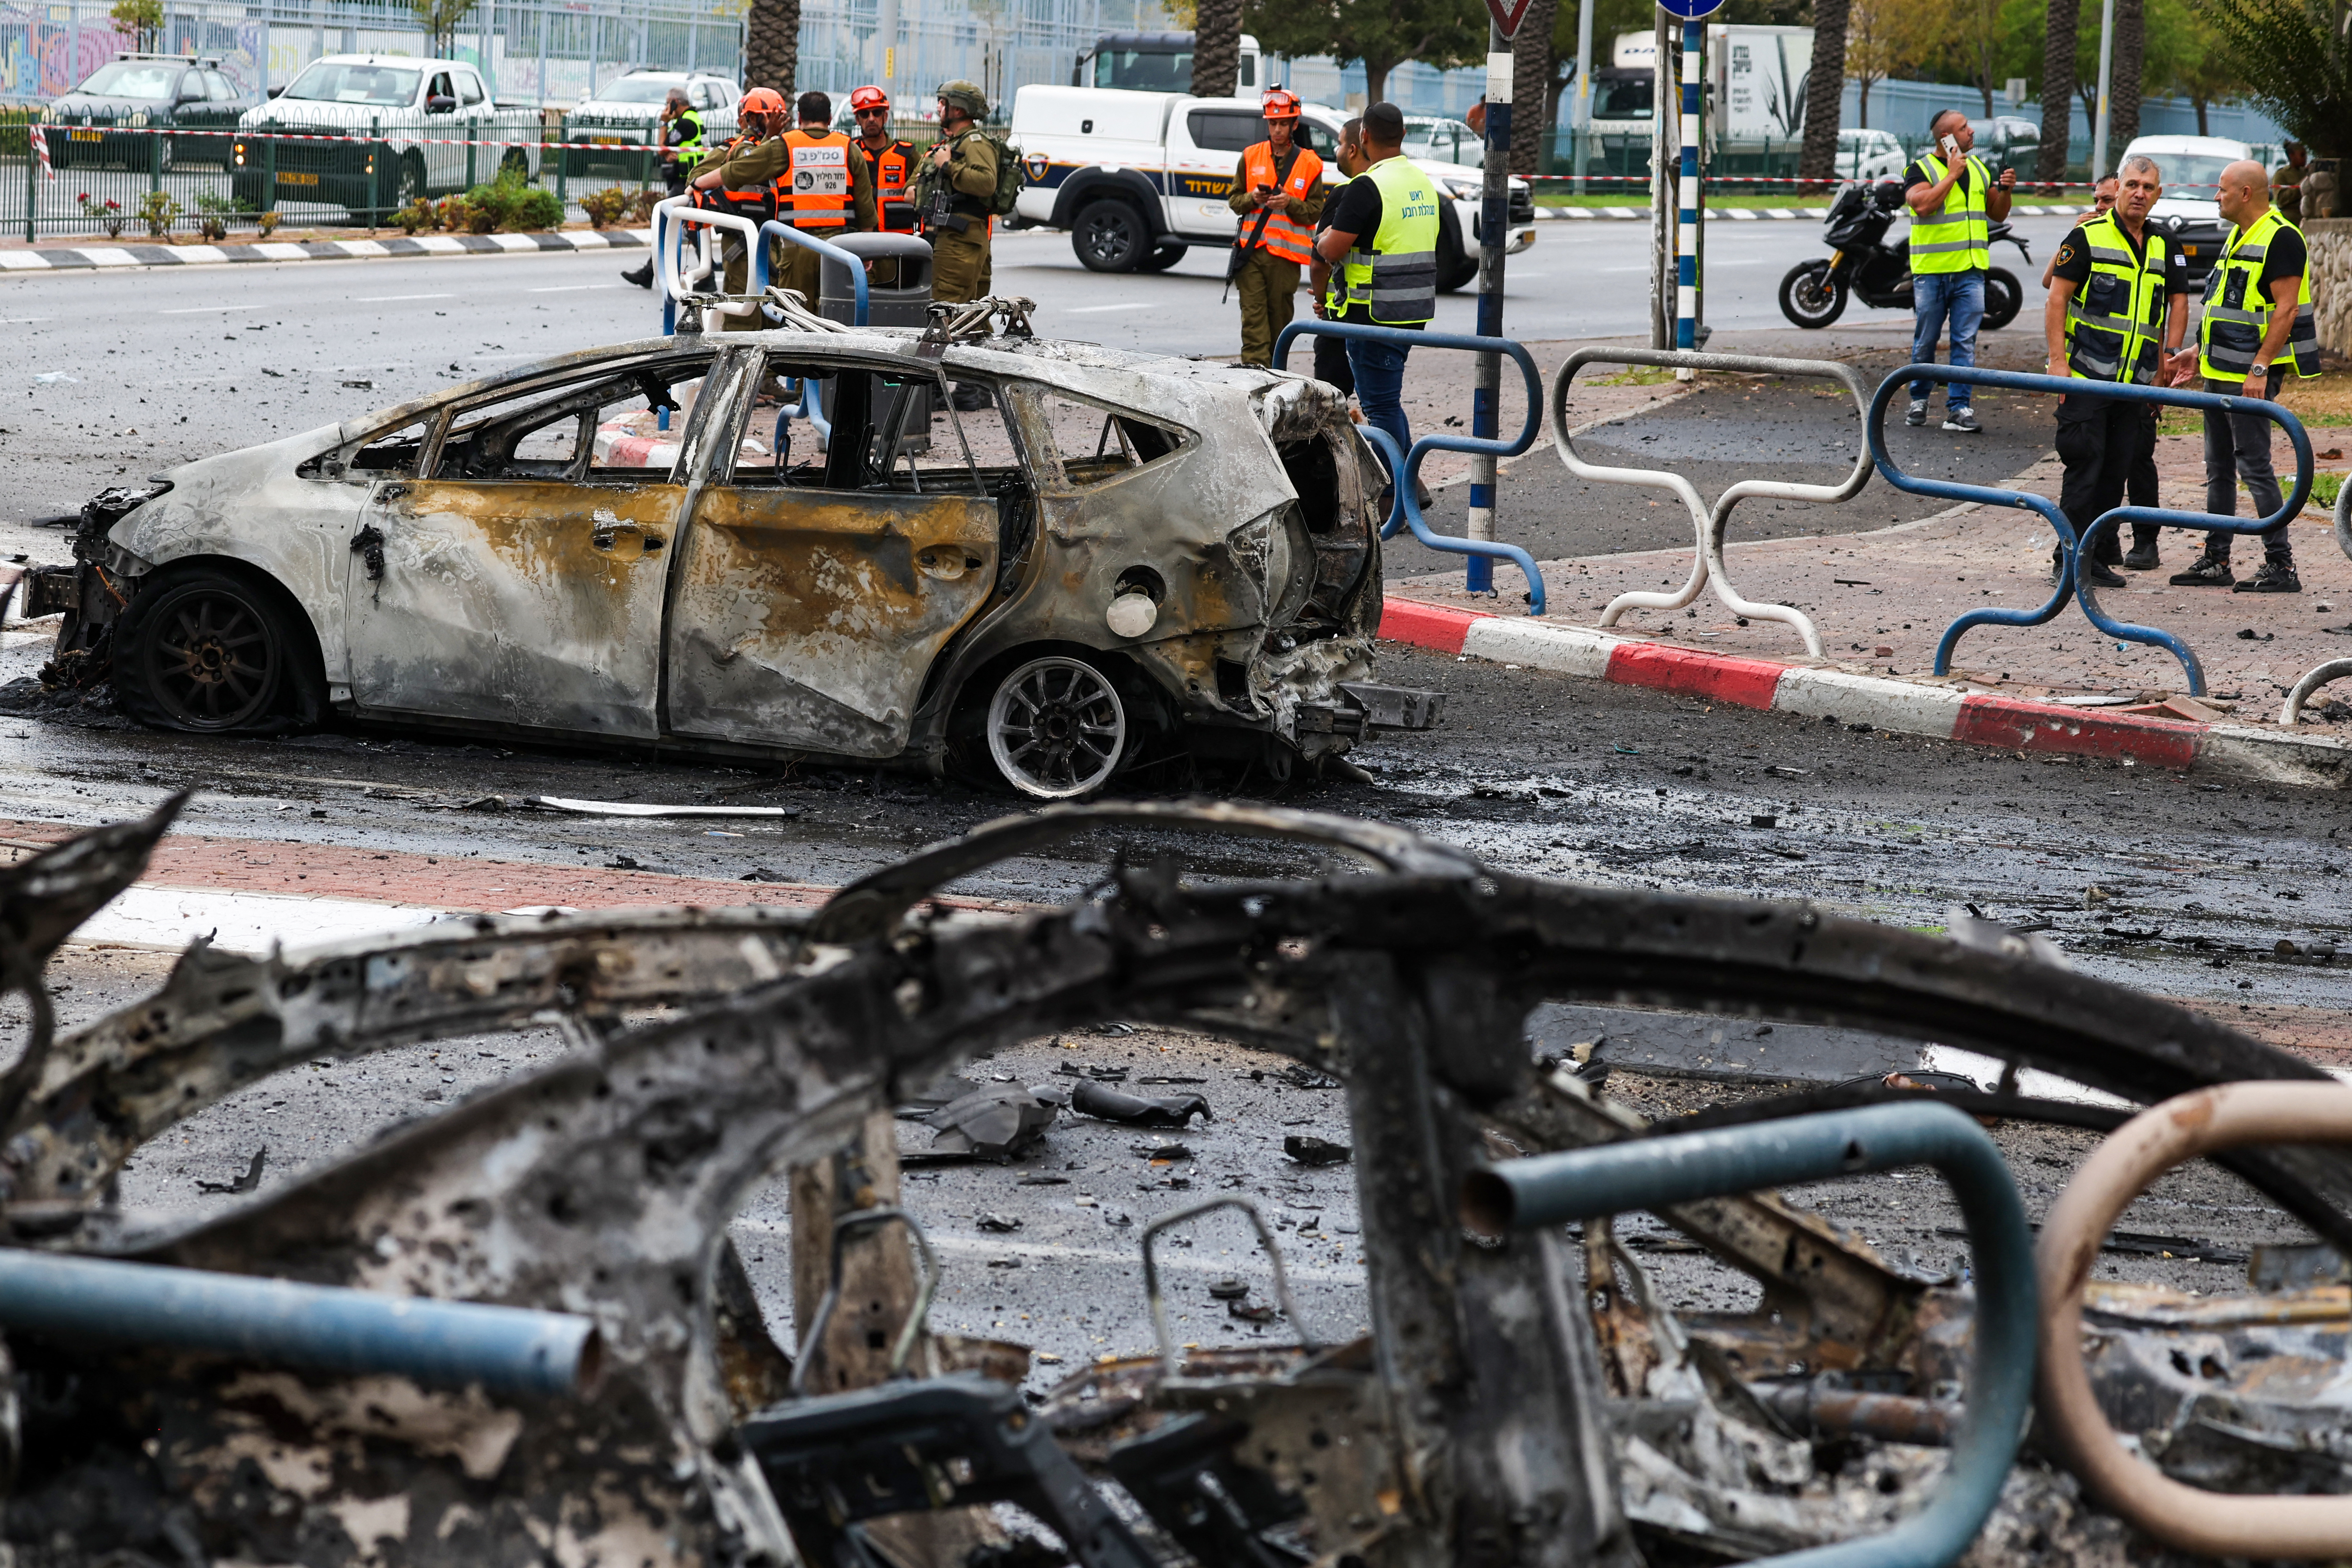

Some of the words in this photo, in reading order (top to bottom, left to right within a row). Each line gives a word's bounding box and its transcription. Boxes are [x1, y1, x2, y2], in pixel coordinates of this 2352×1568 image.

[816, 171, 832, 181] חילוץ
[1409, 190, 1424, 201] ראש
[1402, 206, 1418, 219] רובע
[1418, 203, 1435, 216] מנהלת
